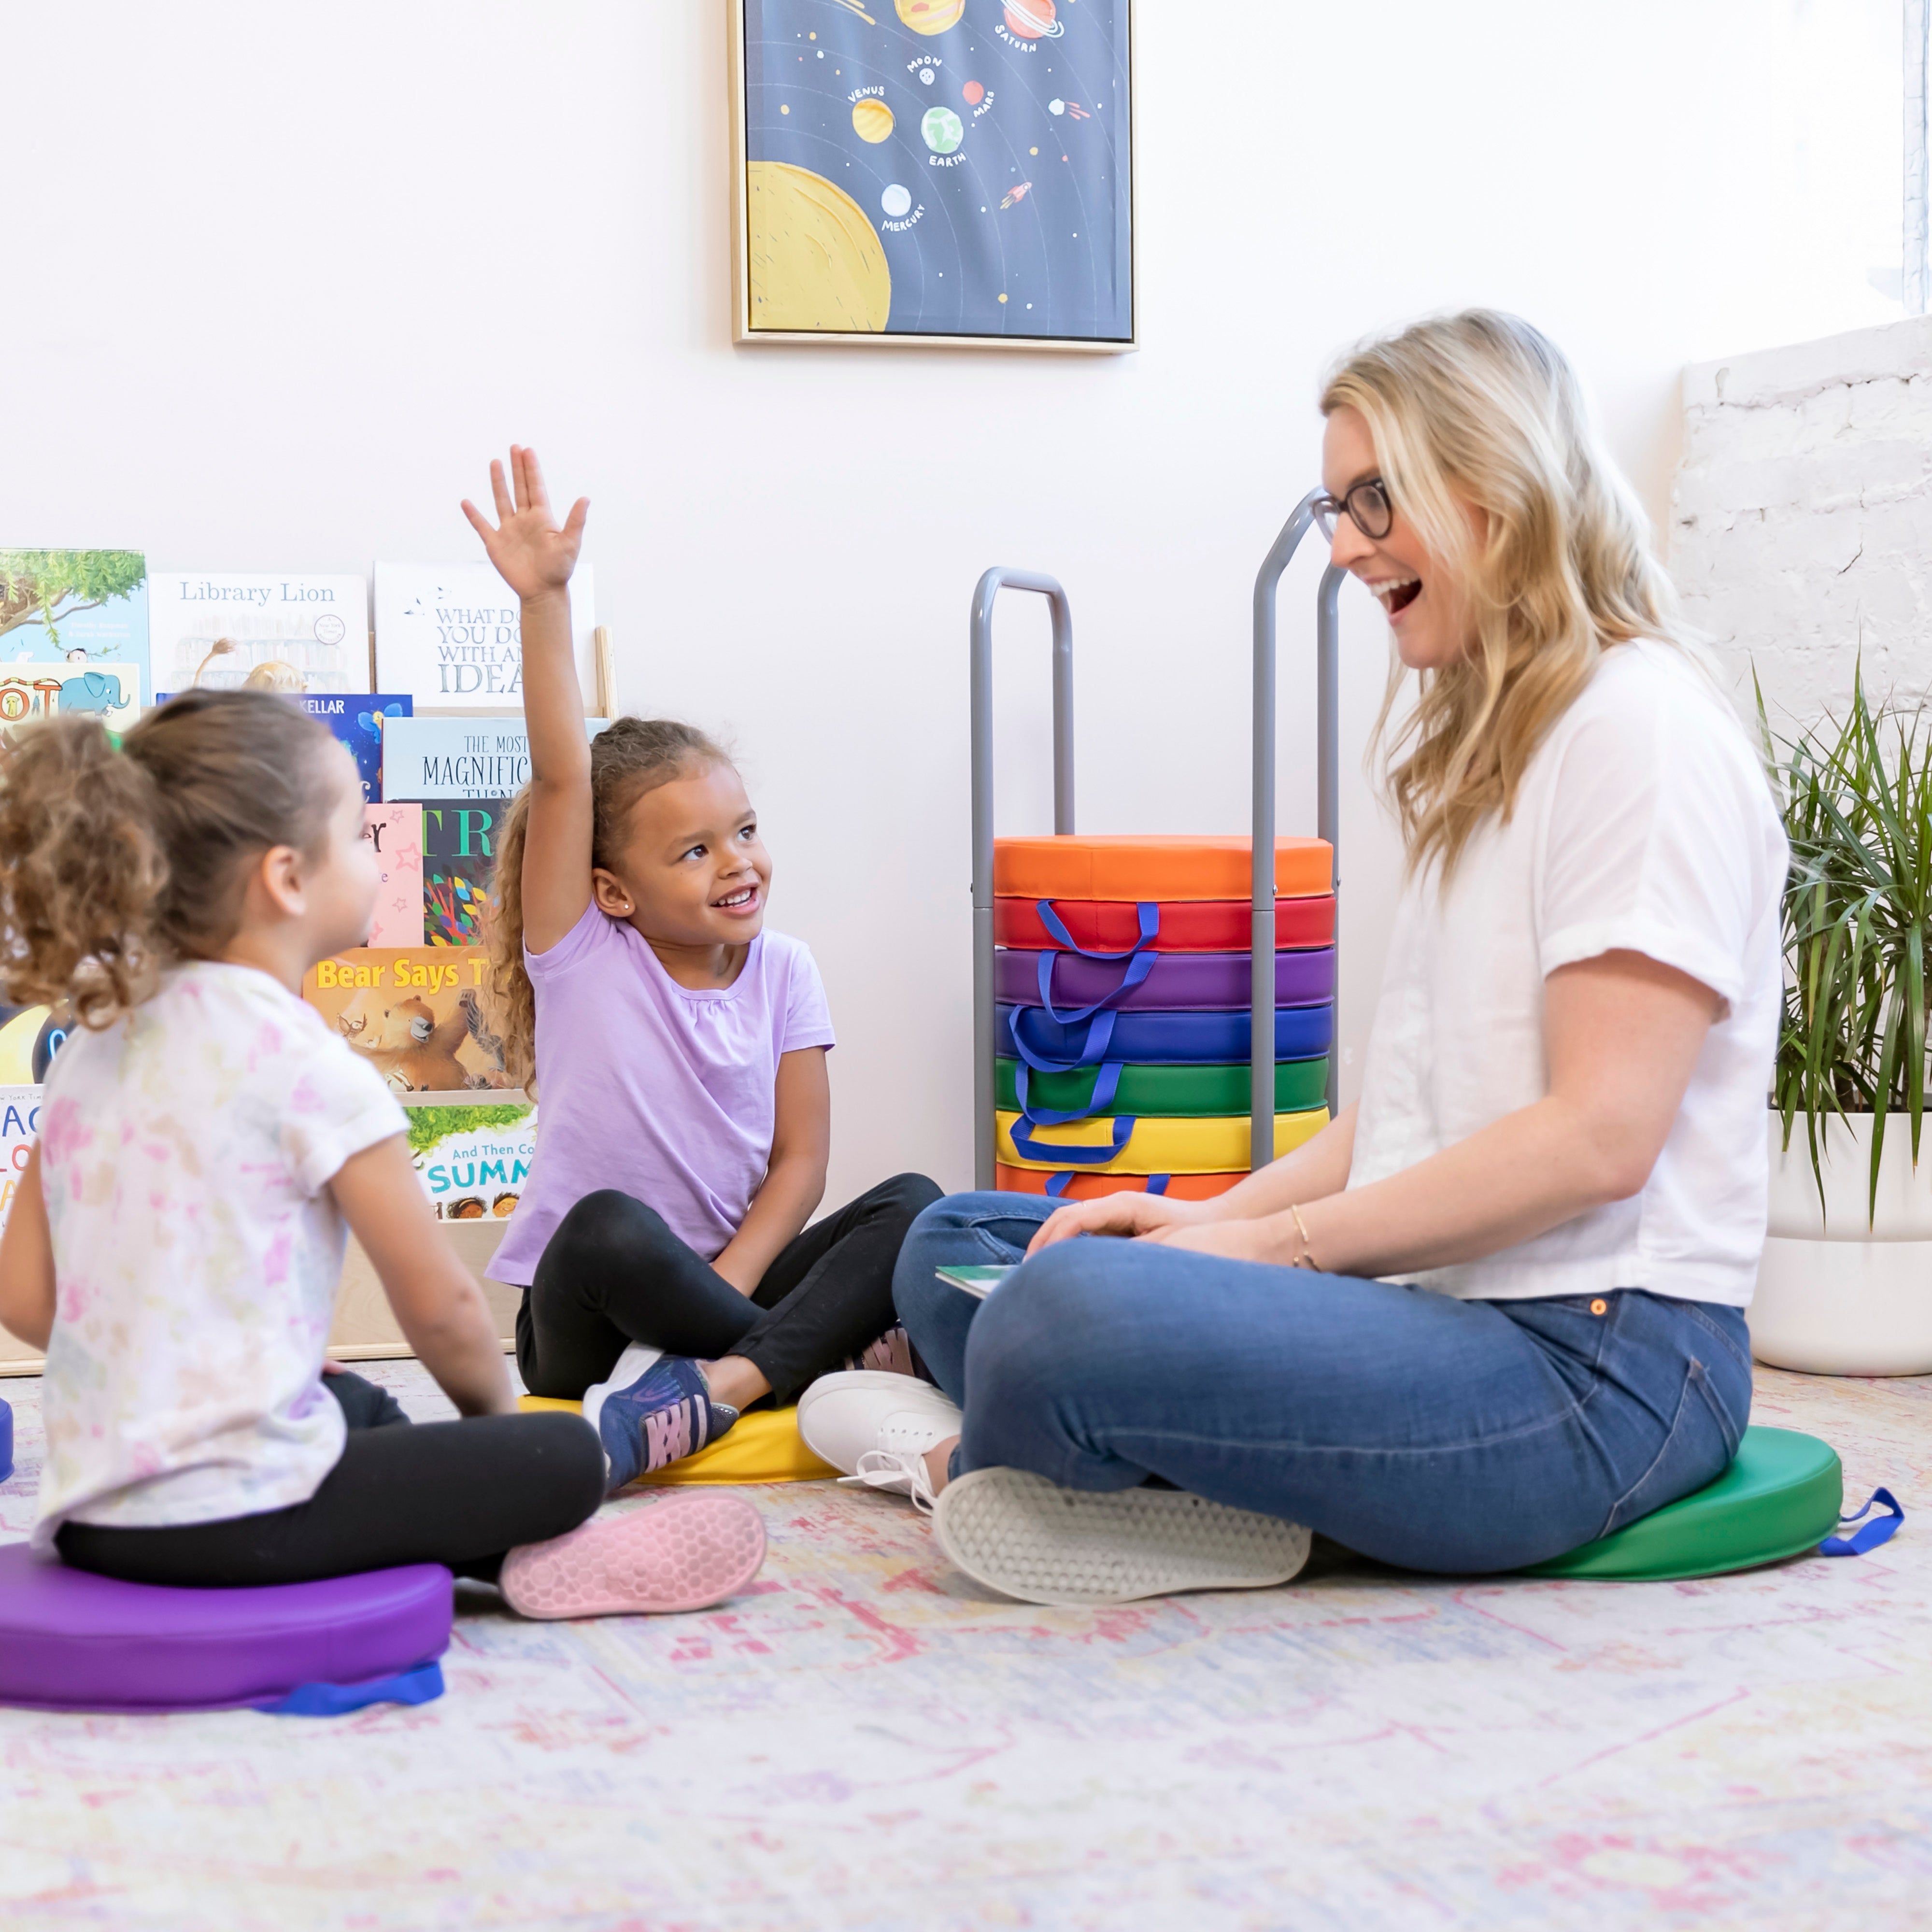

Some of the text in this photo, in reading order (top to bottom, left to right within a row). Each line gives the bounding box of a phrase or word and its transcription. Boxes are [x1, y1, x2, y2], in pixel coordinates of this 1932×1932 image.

[995, 25, 1037, 52] SATURN
[907, 56, 942, 73] MOON
[847, 85, 885, 102] VENUS
[973, 90, 994, 118] MARS
[928, 152, 966, 168] EARTH
[881, 203, 925, 232] MERCURY
[179, 582, 336, 607] Library Lion
[436, 609, 495, 624] WHAT
[437, 626, 486, 644] YOU
[438, 646, 496, 662] WITH
[438, 663, 523, 694] IDEA
[464, 736, 528, 753] THE MOST
[422, 756, 528, 786] MAGNIFIC
[317, 960, 385, 989] Bear
[393, 958, 459, 995] Says
[453, 1145, 478, 1160] And
[482, 1144, 514, 1156] Then
